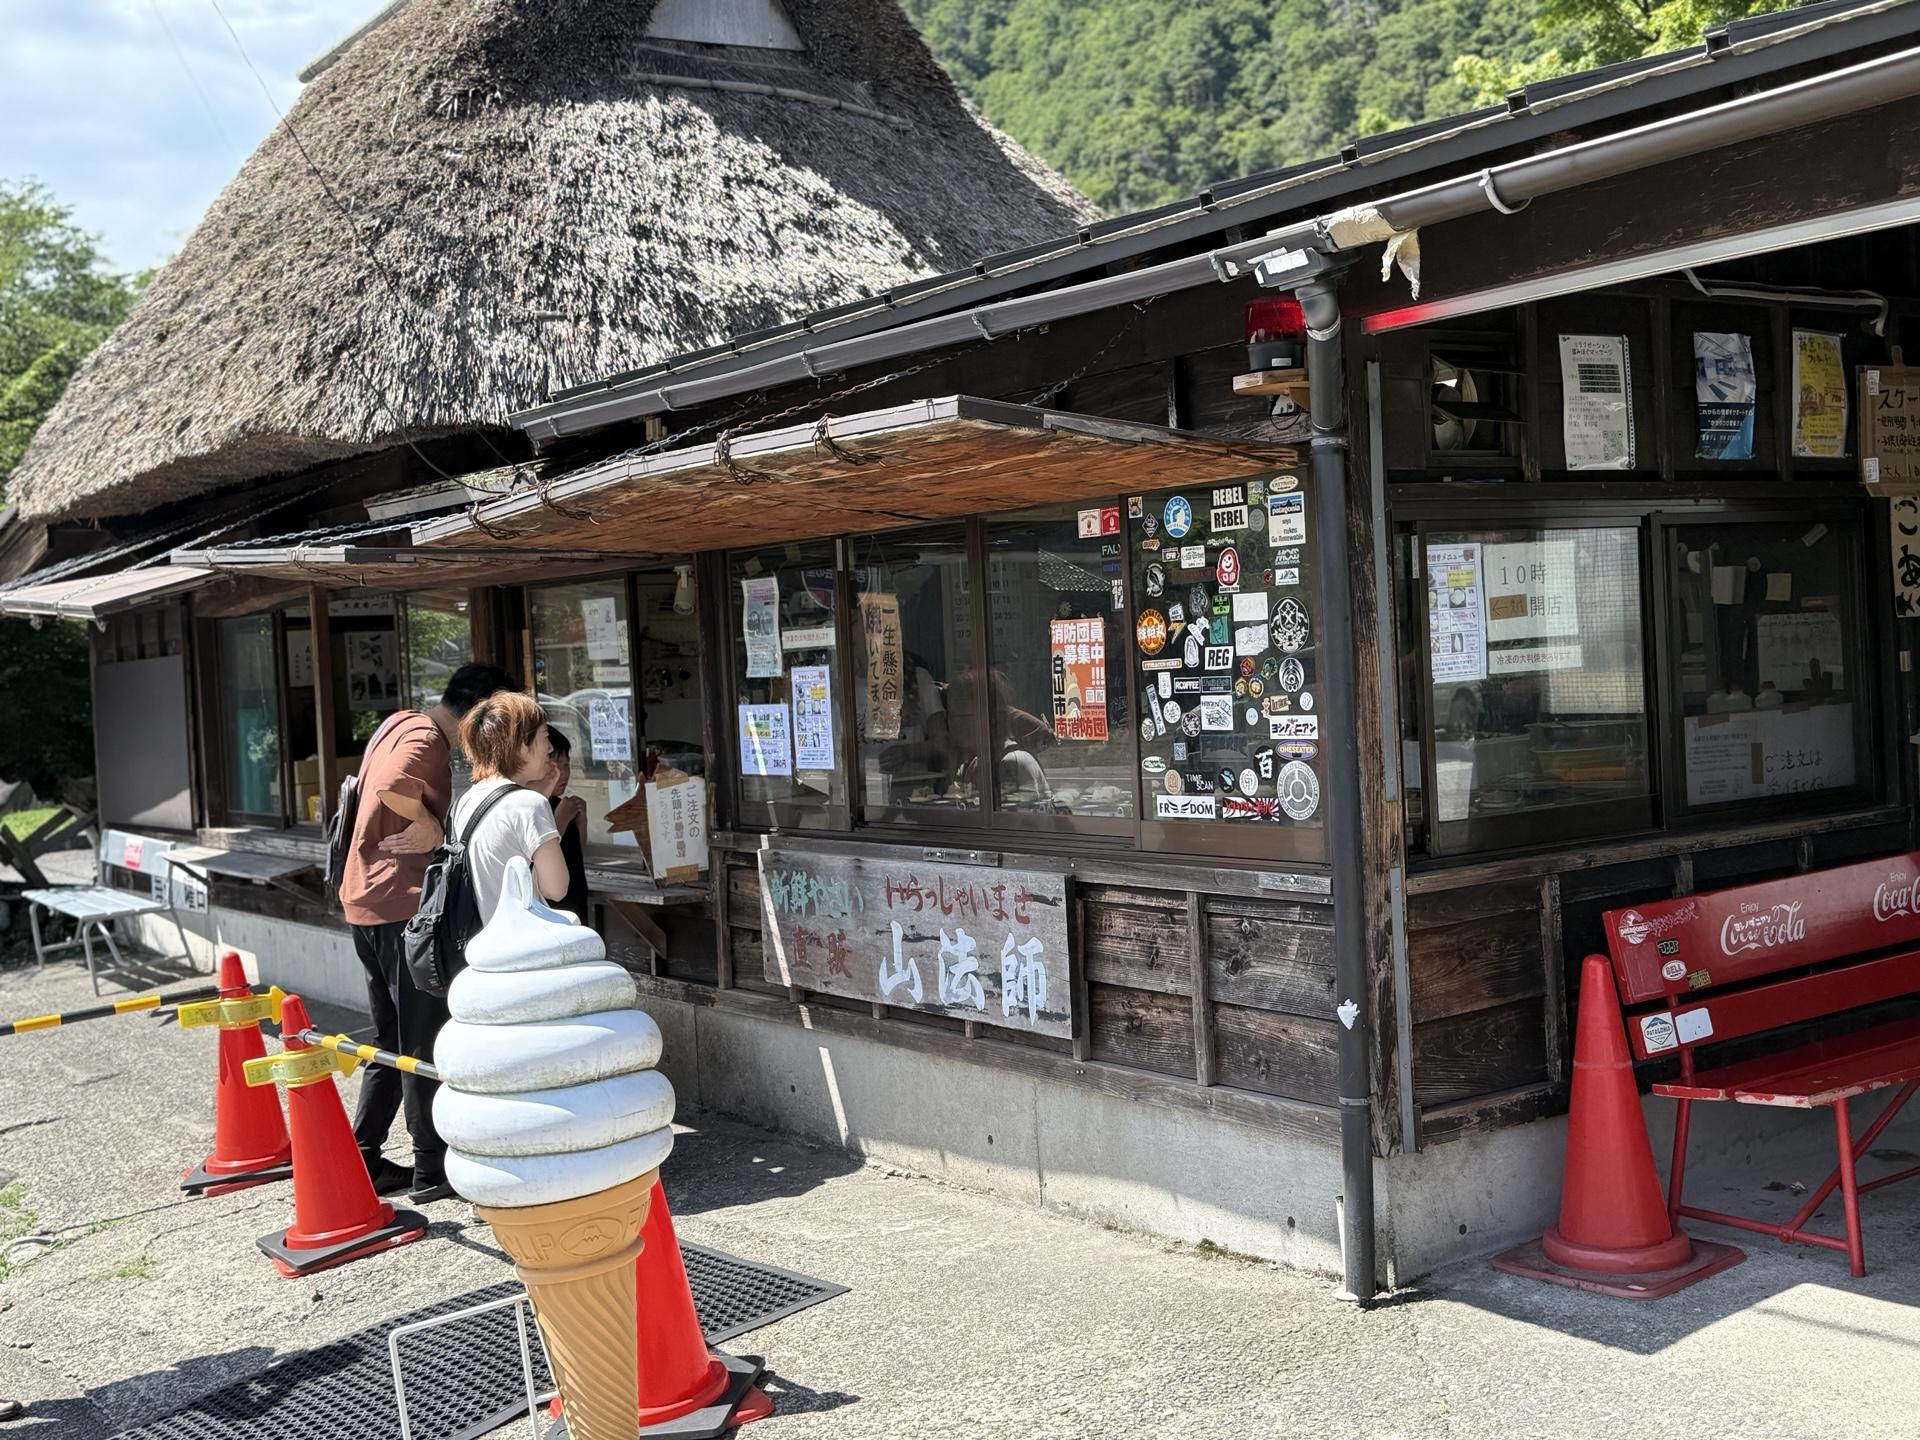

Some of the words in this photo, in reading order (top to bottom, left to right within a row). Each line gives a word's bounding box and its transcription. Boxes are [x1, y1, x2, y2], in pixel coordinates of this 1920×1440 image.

[1212, 487, 1244, 506] REBEL
[1214, 509, 1245, 528] REBEL
[1272, 505, 1301, 516] patagonia
[1500, 563, 1547, 586] 10時
[1529, 595, 1564, 618] 開店
[1051, 622, 1104, 644] 消防団員
[881, 608, 898, 702] 一生懸命
[1064, 645, 1105, 665] 募集中
[1207, 648, 1231, 667] REG
[1052, 655, 1067, 716] 白山市
[1055, 717, 1107, 738] 南消防団
[1271, 723, 1317, 733] ヨシノニアン
[1185, 774, 1203, 783] TIME
[1196, 780, 1214, 791] SCAN
[671, 787, 684, 821] 先頭は
[686, 784, 701, 838] ご注文の
[1890, 872, 1907, 882] Enjoy
[885, 872, 1034, 924] いらっしゃいませ
[1740, 902, 1759, 913] Enjoy
[879, 920, 1047, 1026] 山法師
[1646, 1026, 1671, 1037] PATAGONIA
